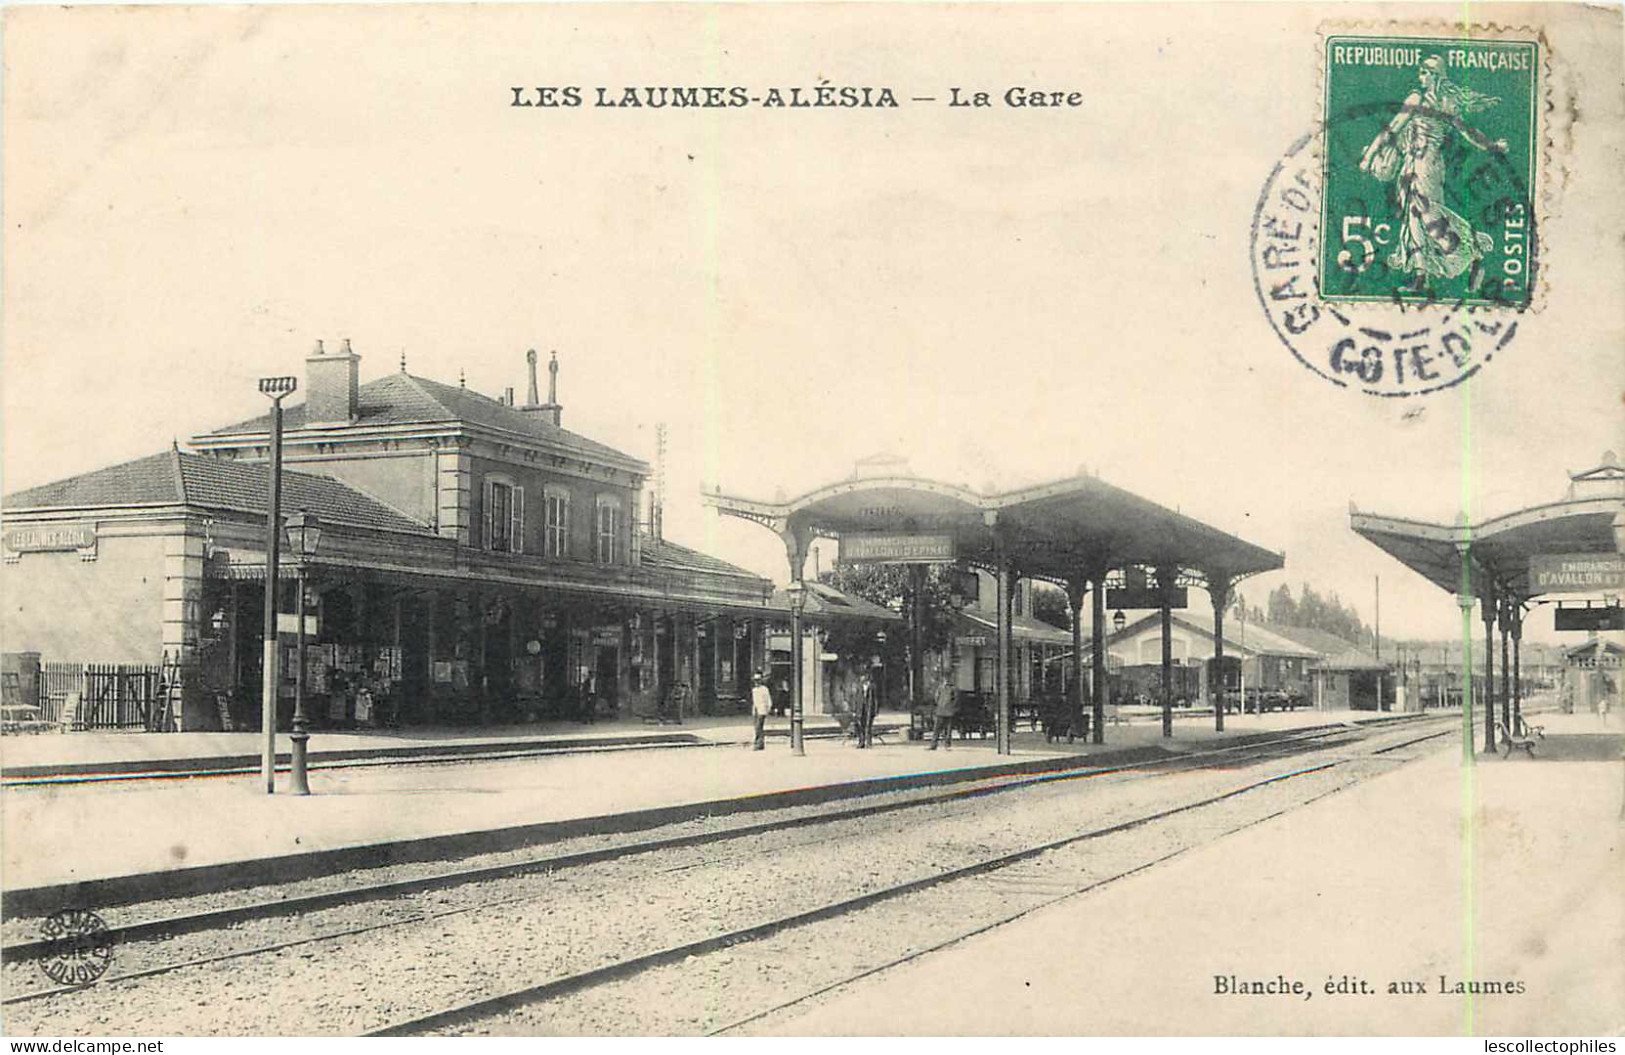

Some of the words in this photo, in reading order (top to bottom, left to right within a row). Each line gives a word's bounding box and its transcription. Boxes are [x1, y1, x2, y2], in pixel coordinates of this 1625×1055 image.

[1448, 49, 1530, 72] FRANÇAISE
[1503, 203, 1525, 292] POSTES
[1539, 571, 1602, 586] D'AVALLON
